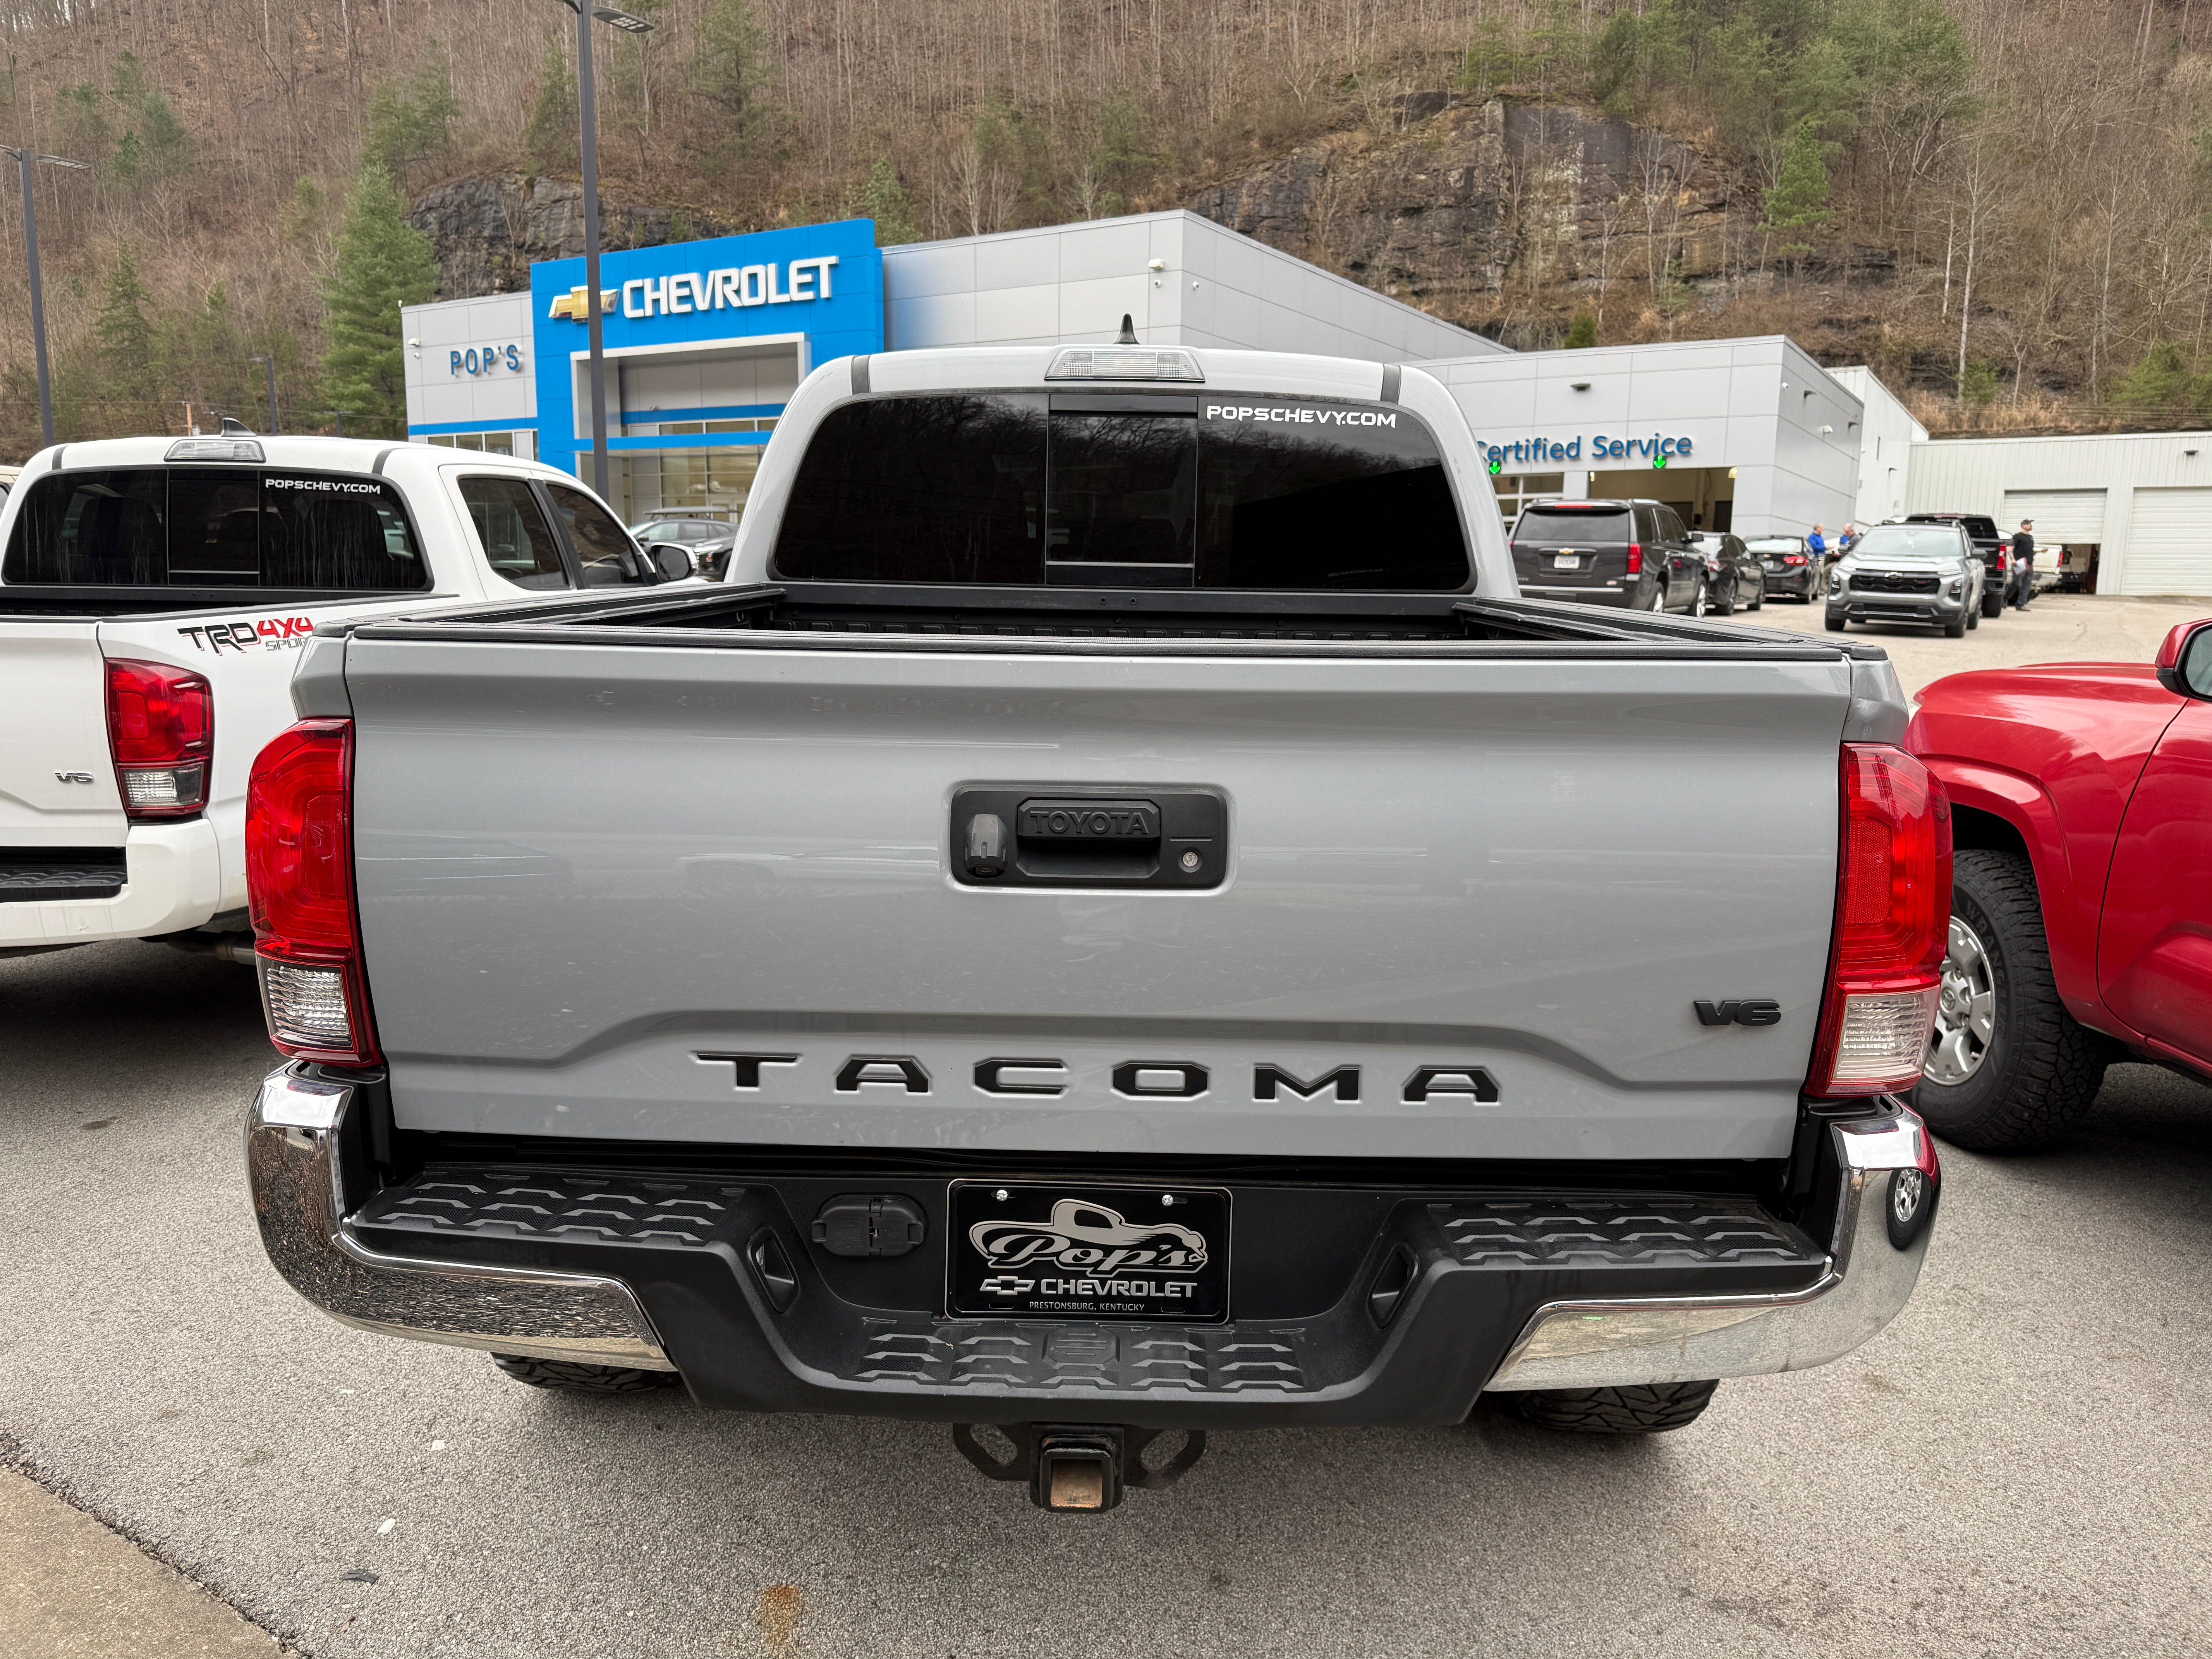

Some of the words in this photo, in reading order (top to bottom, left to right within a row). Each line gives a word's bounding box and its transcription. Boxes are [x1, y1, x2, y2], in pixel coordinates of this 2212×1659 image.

[623, 255, 839, 318] CHEVROLET
[450, 344, 521, 376] POP'S
[1207, 405, 1396, 428] POPSCHEVY.COM
[1591, 432, 1693, 459] Service
[265, 479, 381, 495] POPSCHEVY.COM
[177, 622, 261, 656] TRD
[54, 769, 94, 783] V6
[1030, 811, 1149, 835] TOYOTA
[1693, 999, 1781, 1026] V6
[695, 1052, 1499, 1103] TACOMA
[988, 1234, 1194, 1271] Pop's
[1040, 1279, 1198, 1298] CHEVROLET
[1100, 1303, 1145, 1312] KENTUCKY
